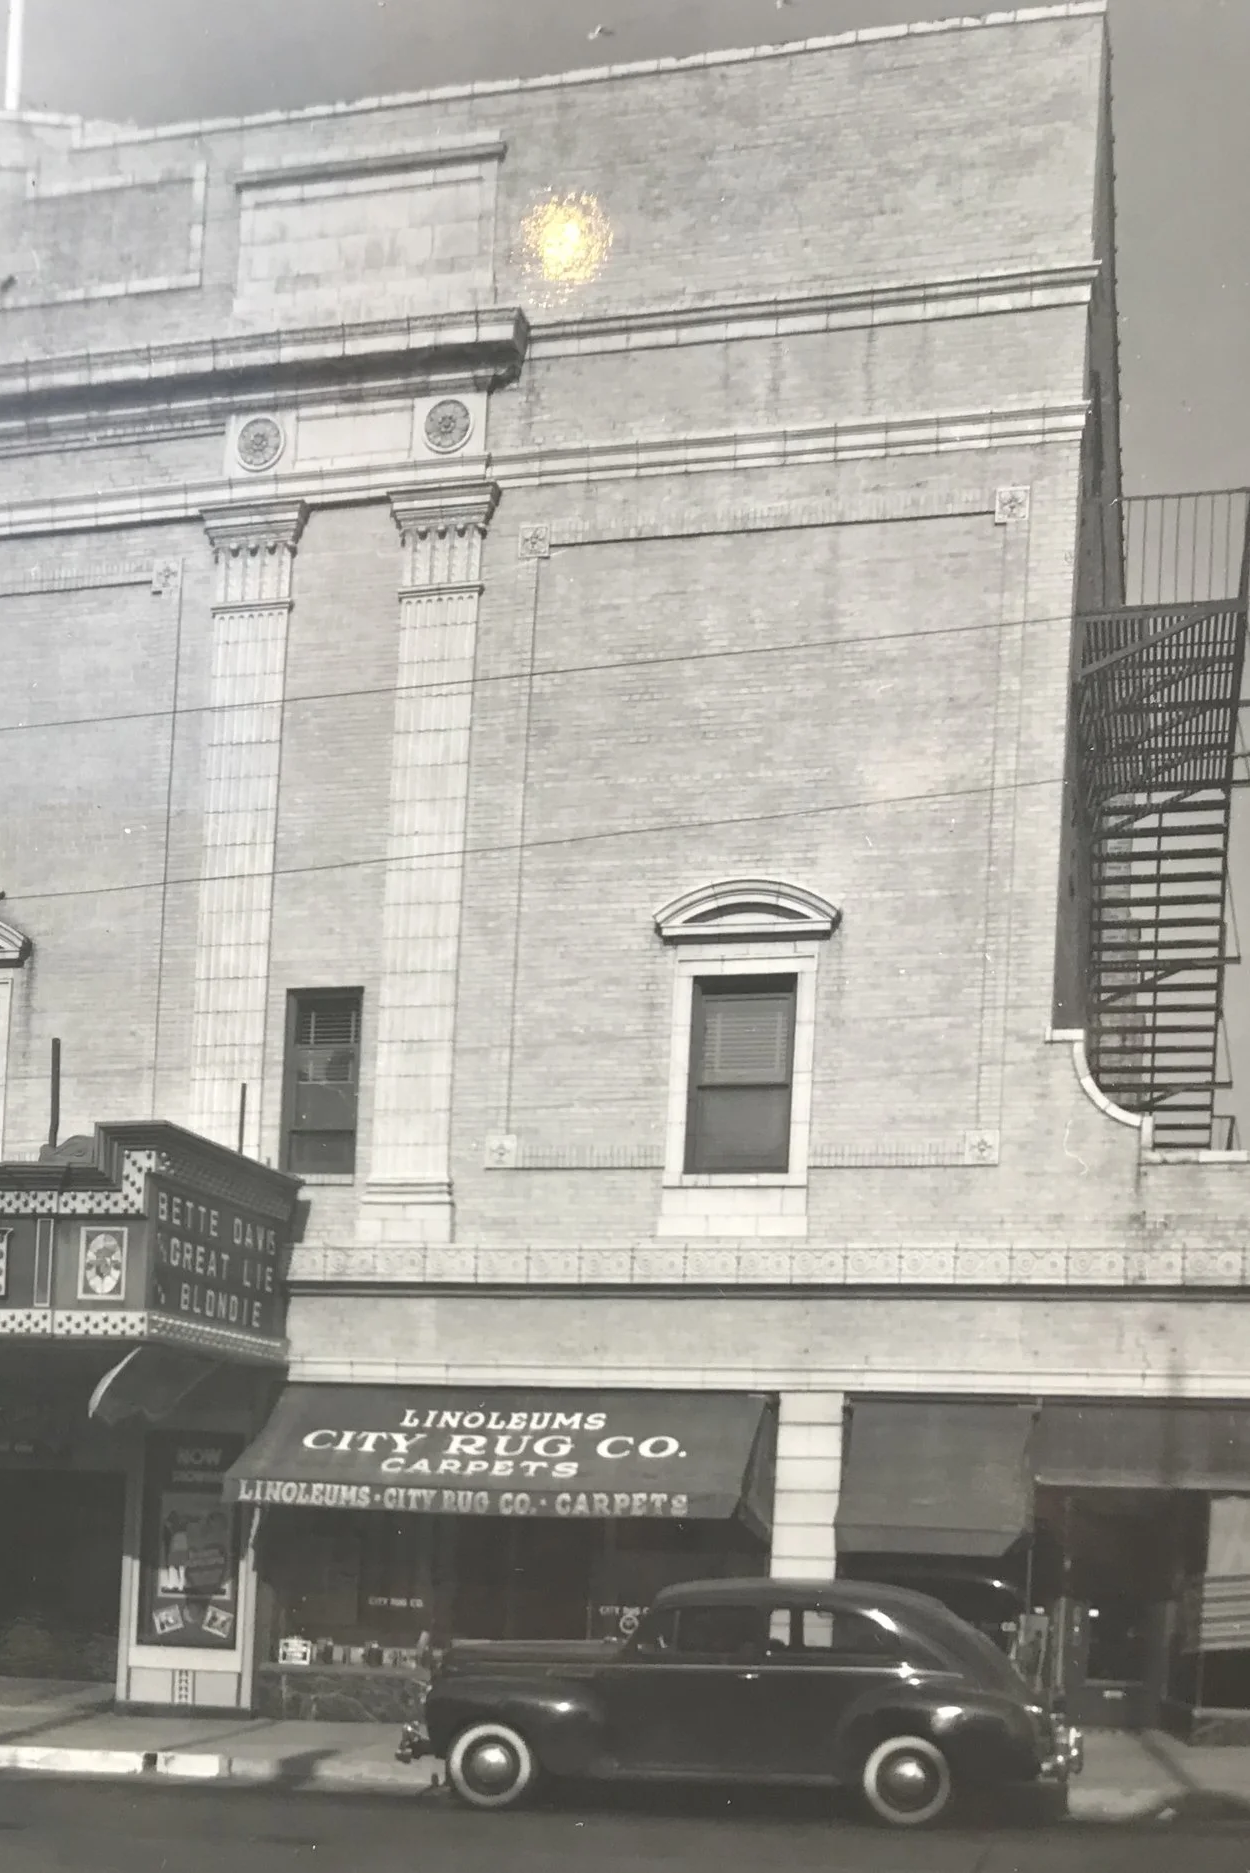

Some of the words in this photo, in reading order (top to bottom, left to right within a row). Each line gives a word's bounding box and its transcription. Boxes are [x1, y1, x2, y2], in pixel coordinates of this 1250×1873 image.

[158, 1191, 220, 1237] BETTE
[169, 1237, 230, 1281] GREAT
[243, 1259, 273, 1293] LIE
[180, 1282, 262, 1328] BLONDIE
[400, 1409, 607, 1431] LINOLEUMS
[176, 1447, 223, 1465] NOW
[302, 1429, 427, 1454] CITY
[442, 1434, 575, 1457] RUG
[596, 1436, 687, 1458] CO.
[381, 1457, 579, 1478] CARPETS
[238, 1479, 371, 1509] LINOLEUMS
[383, 1487, 437, 1510] CITY
[443, 1489, 489, 1514] RUG
[500, 1492, 537, 1515] CO.
[555, 1492, 688, 1516] CARPETS
